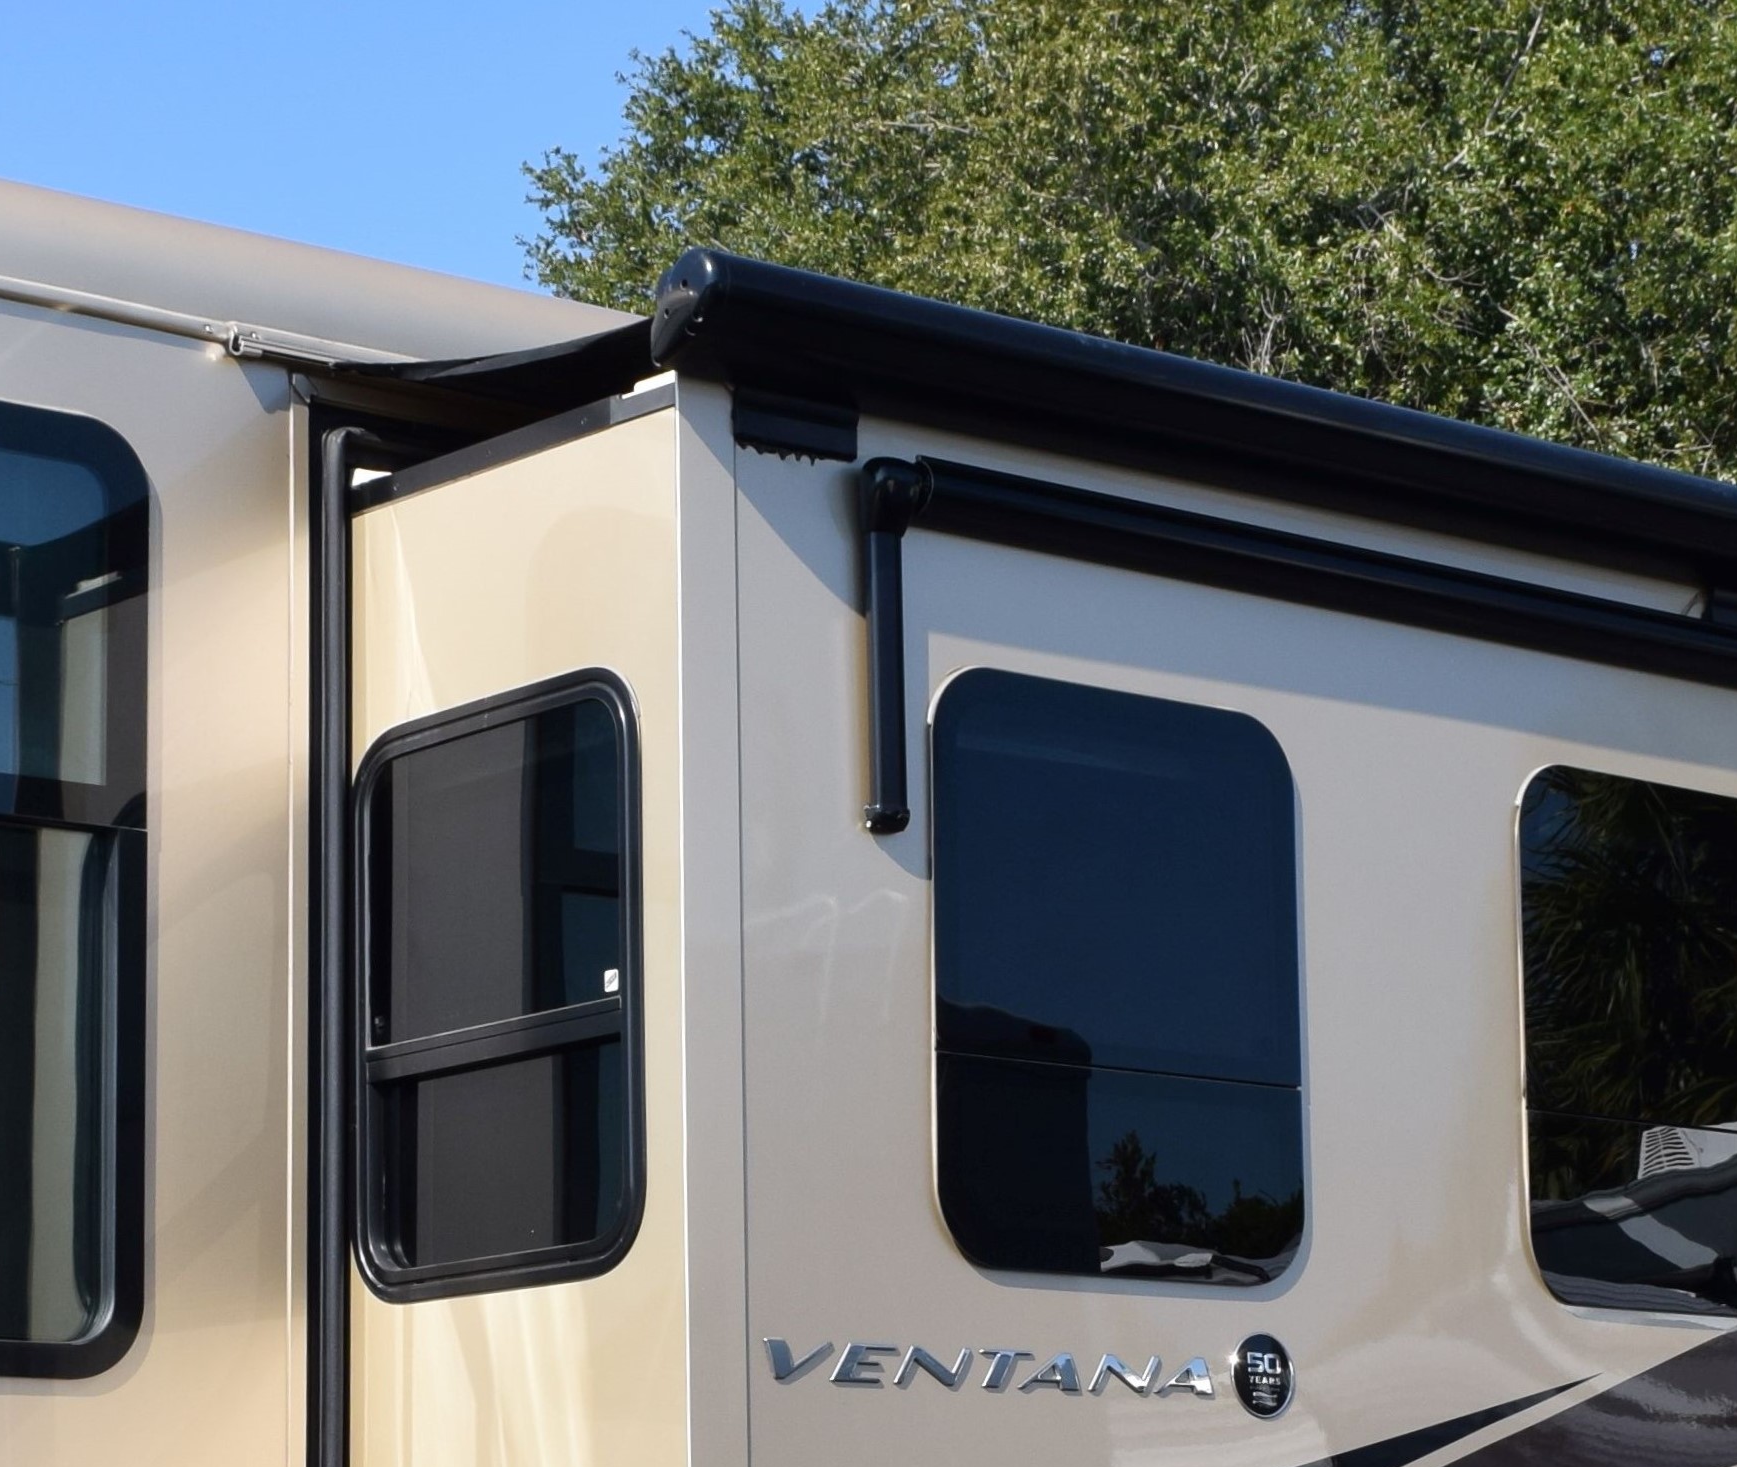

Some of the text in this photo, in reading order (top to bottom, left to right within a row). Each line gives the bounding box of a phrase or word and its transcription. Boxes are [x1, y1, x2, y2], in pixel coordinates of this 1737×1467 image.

[762, 1336, 1215, 1395] VENTANA
[1246, 1351, 1282, 1375] 50
[1248, 1375, 1282, 1386] YEARS
